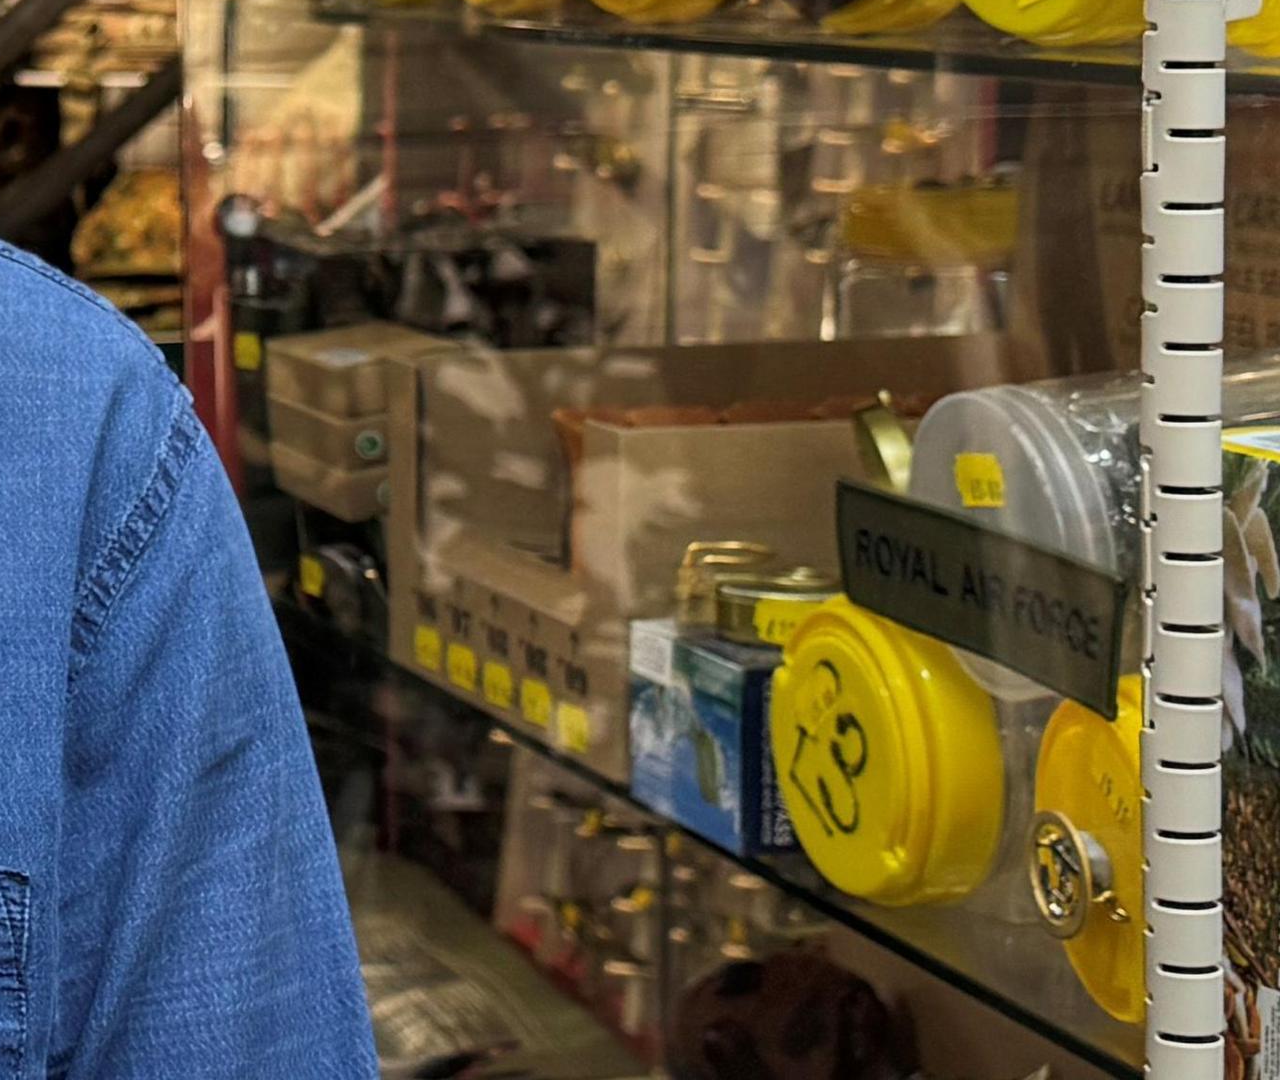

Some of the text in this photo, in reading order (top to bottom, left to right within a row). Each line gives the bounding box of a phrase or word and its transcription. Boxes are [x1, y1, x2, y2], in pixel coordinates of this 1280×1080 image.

[855, 528, 1100, 661] ROYAL AIR FORCE
